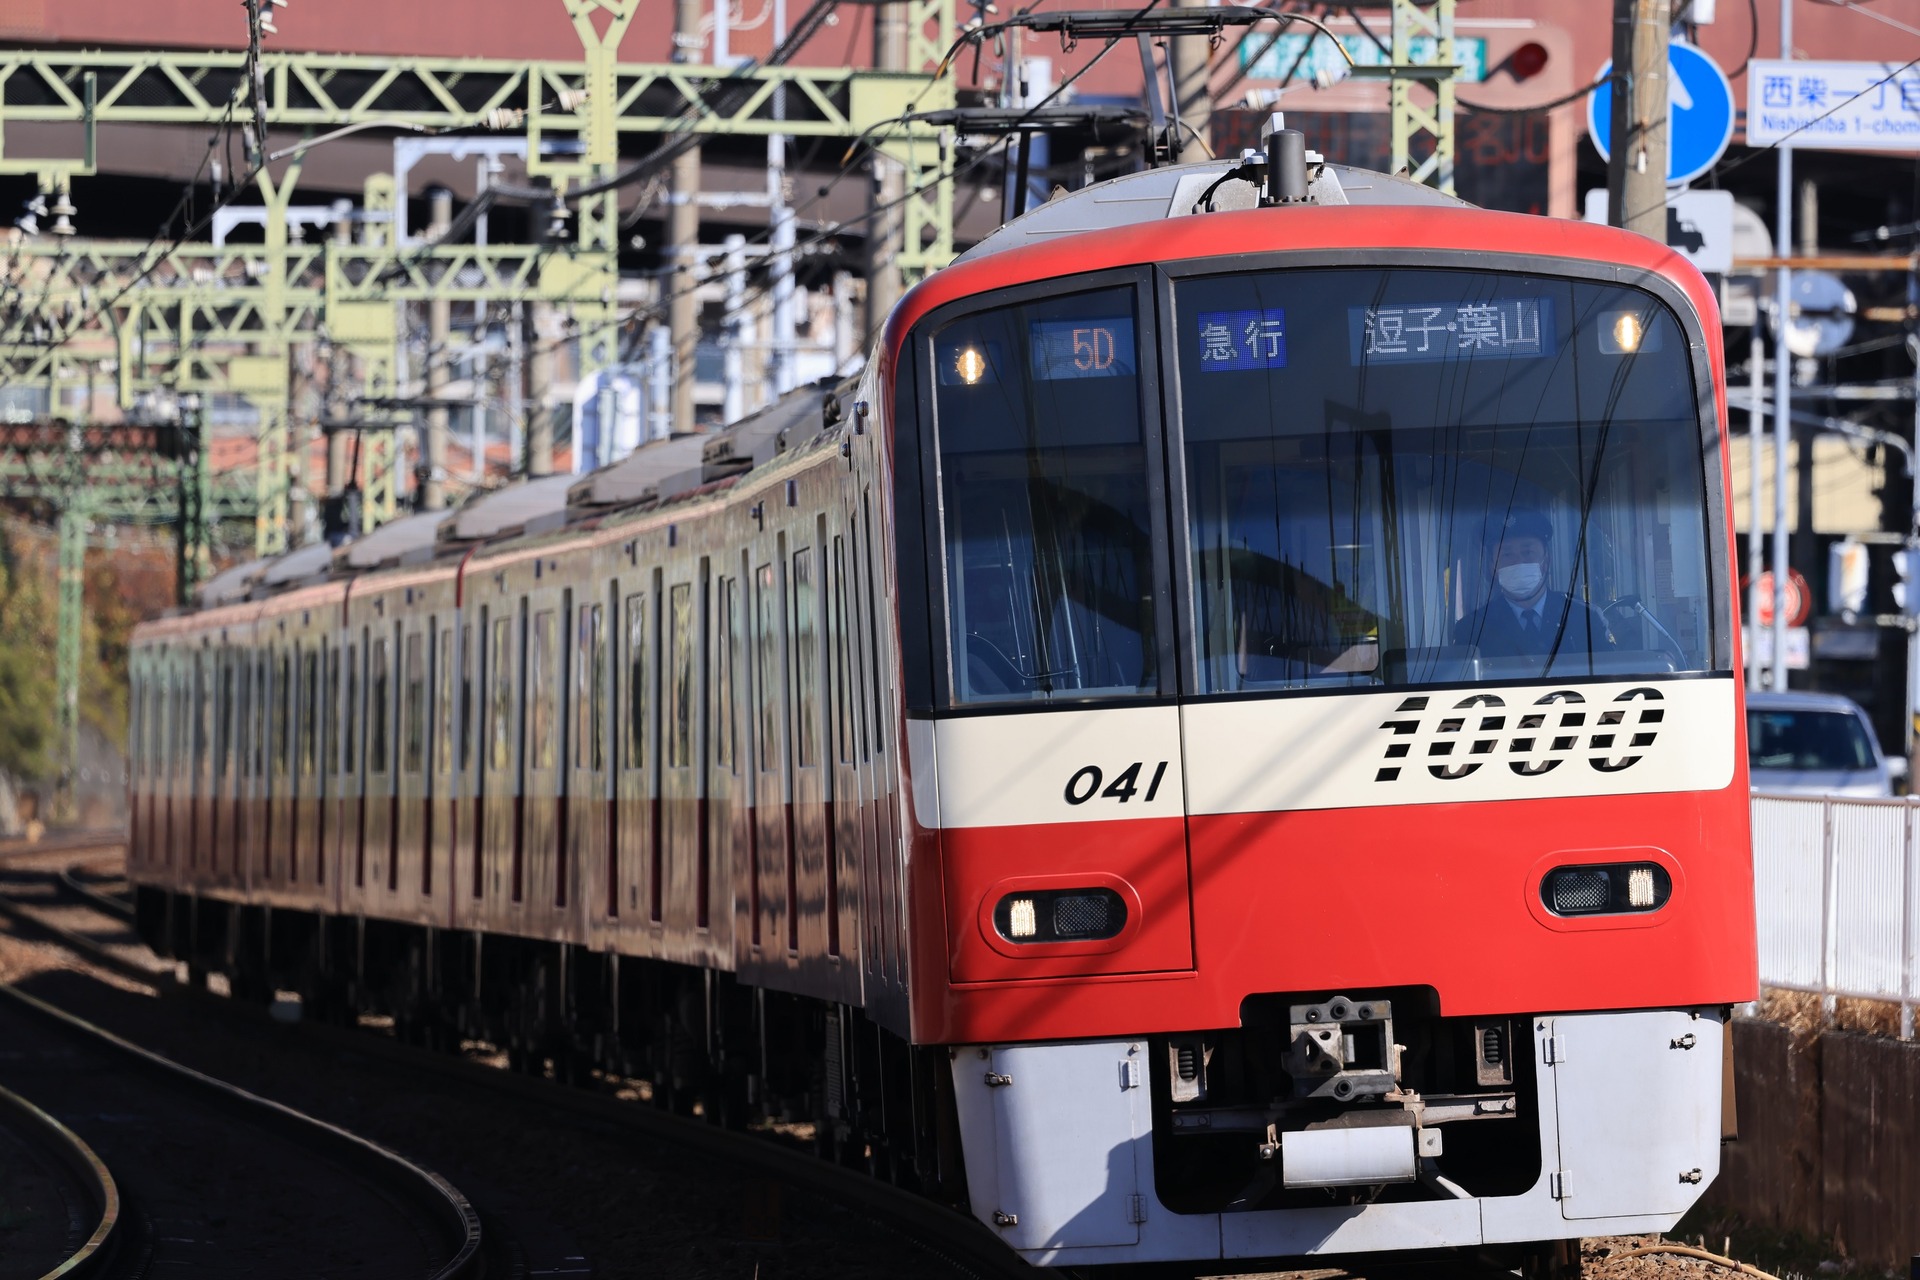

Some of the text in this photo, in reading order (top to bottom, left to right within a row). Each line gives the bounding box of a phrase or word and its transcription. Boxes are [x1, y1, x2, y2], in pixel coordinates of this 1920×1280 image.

[1762, 115, 1846, 133] Nishishiba
[1073, 328, 1114, 370] 5D
[1201, 320, 1282, 360] 急行
[1375, 687, 1665, 782] 1000
[1064, 761, 1168, 805] 041
